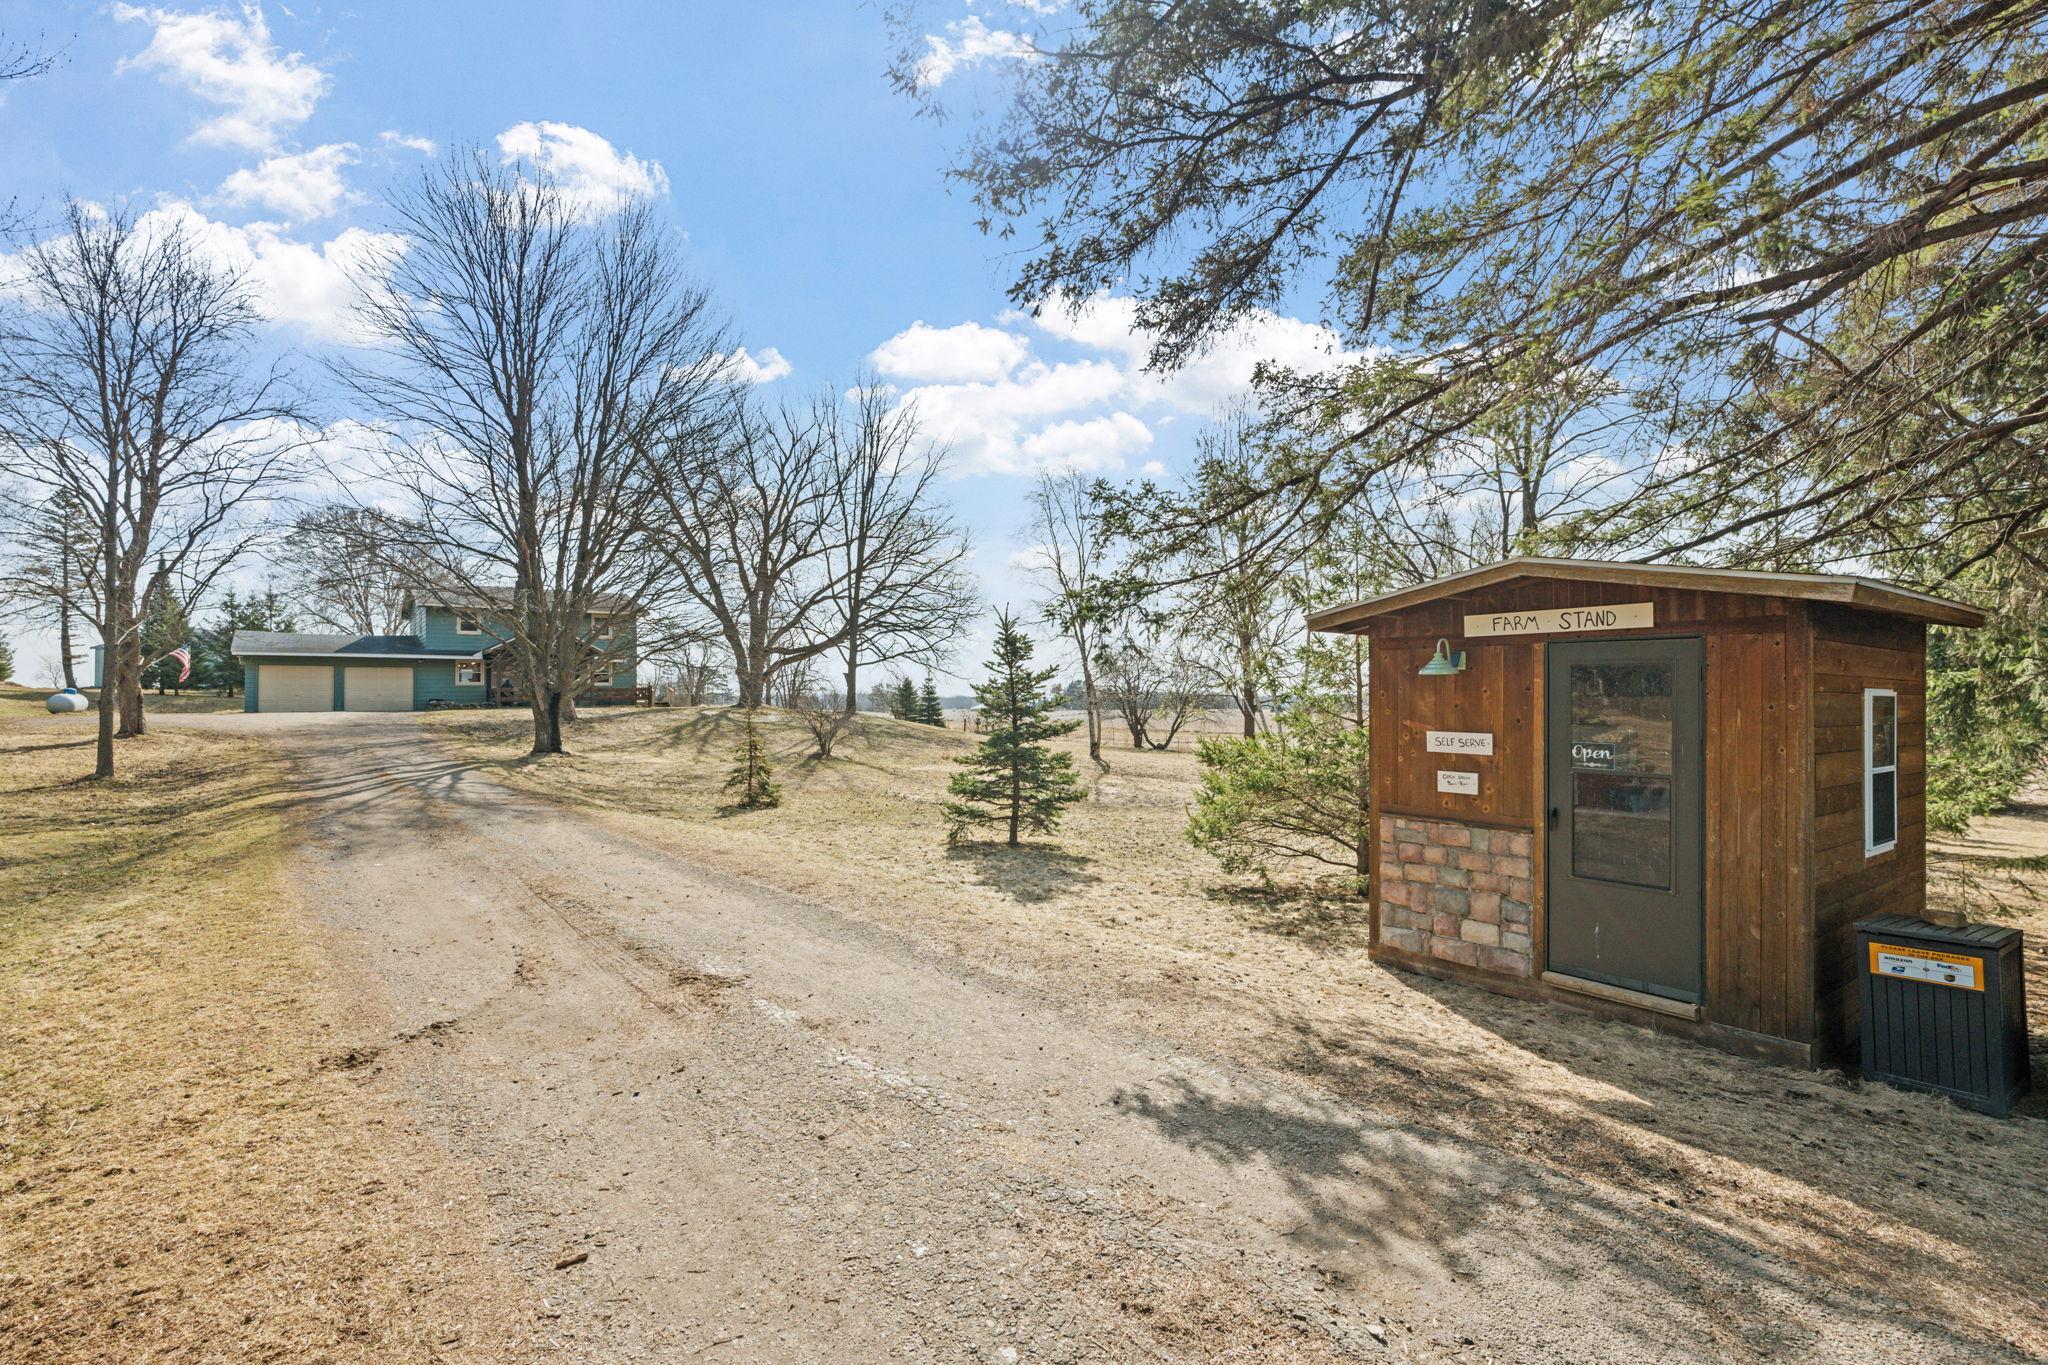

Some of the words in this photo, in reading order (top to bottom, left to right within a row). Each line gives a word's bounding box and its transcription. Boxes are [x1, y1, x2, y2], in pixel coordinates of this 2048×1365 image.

[1492, 615, 1540, 631] FARM
[1558, 610, 1617, 630] STAND
[1434, 737, 1455, 747] SELF
[1458, 738, 1486, 748] SERVE
[1572, 744, 1614, 762] Open
[1884, 955, 1913, 964] amazon
[1932, 952, 1970, 962] PACKAGES
[1936, 963, 1959, 971] FedEx
